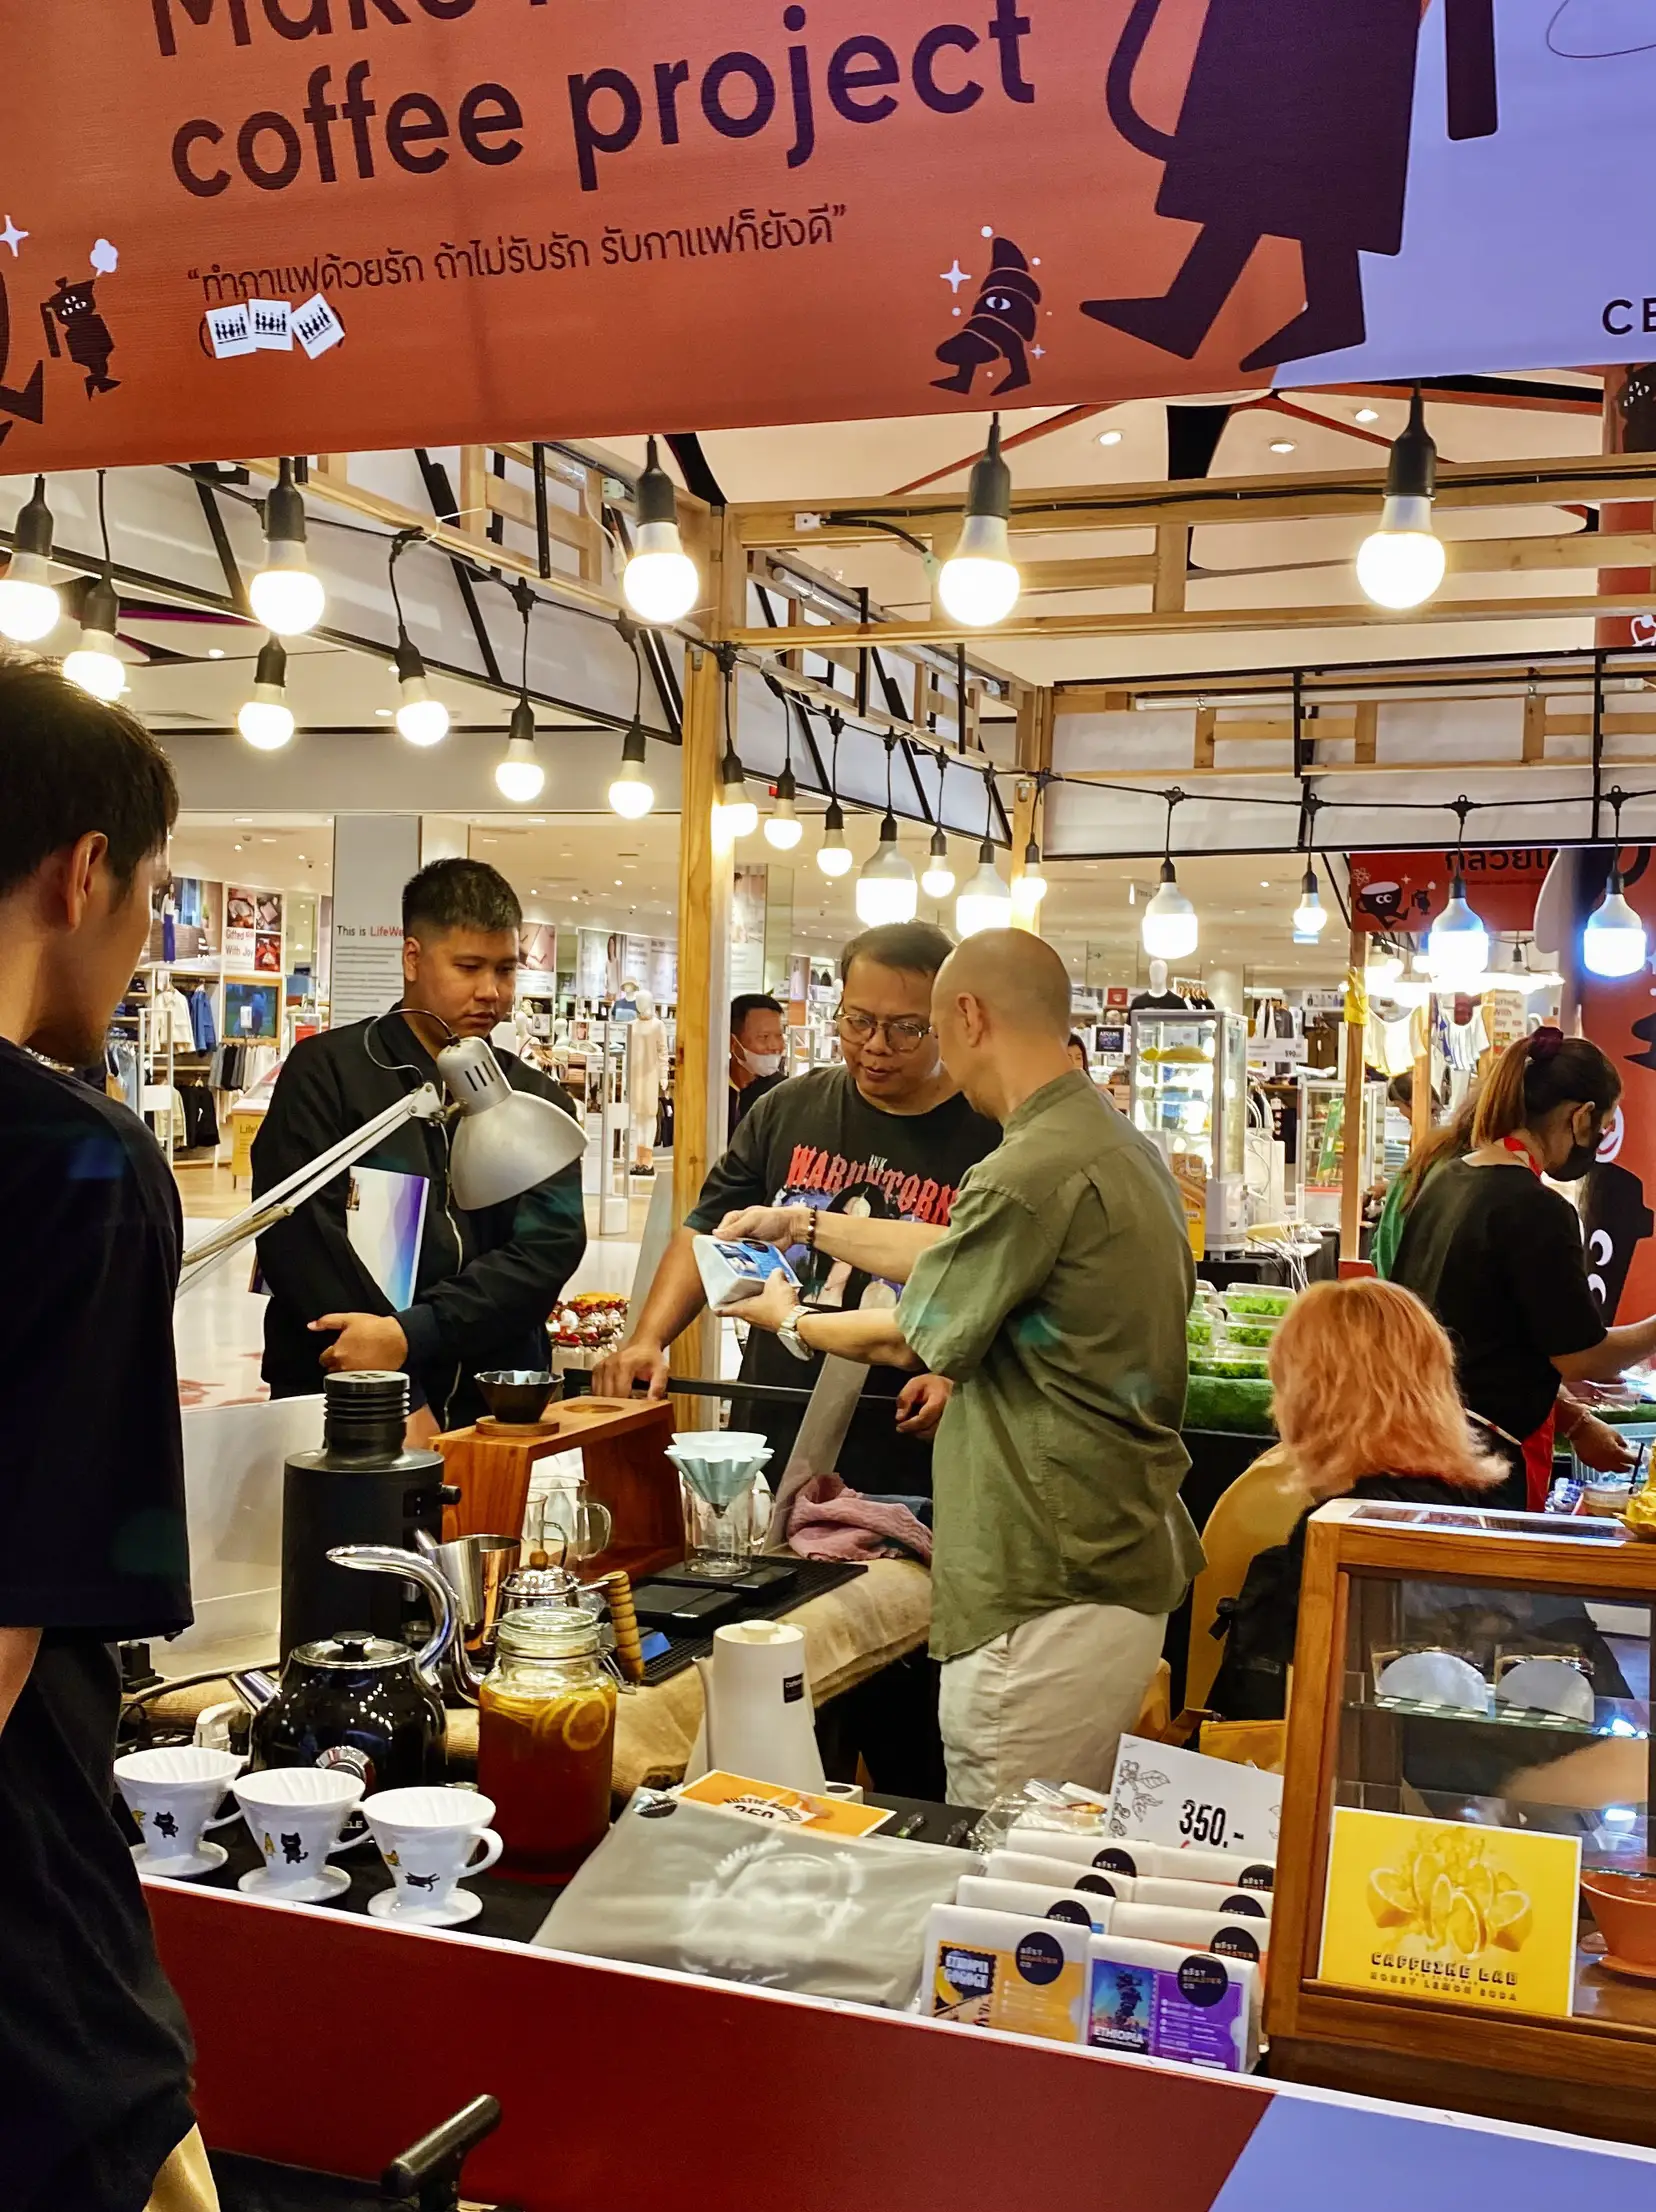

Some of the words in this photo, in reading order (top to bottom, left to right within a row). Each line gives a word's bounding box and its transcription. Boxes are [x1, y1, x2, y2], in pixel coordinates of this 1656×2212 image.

[172, 60, 524, 198] coffee
[568, 4, 1036, 192] project
[336, 925, 356, 937] This
[359, 927, 367, 937] is
[1424, 1980, 1473, 1995] LEMON
